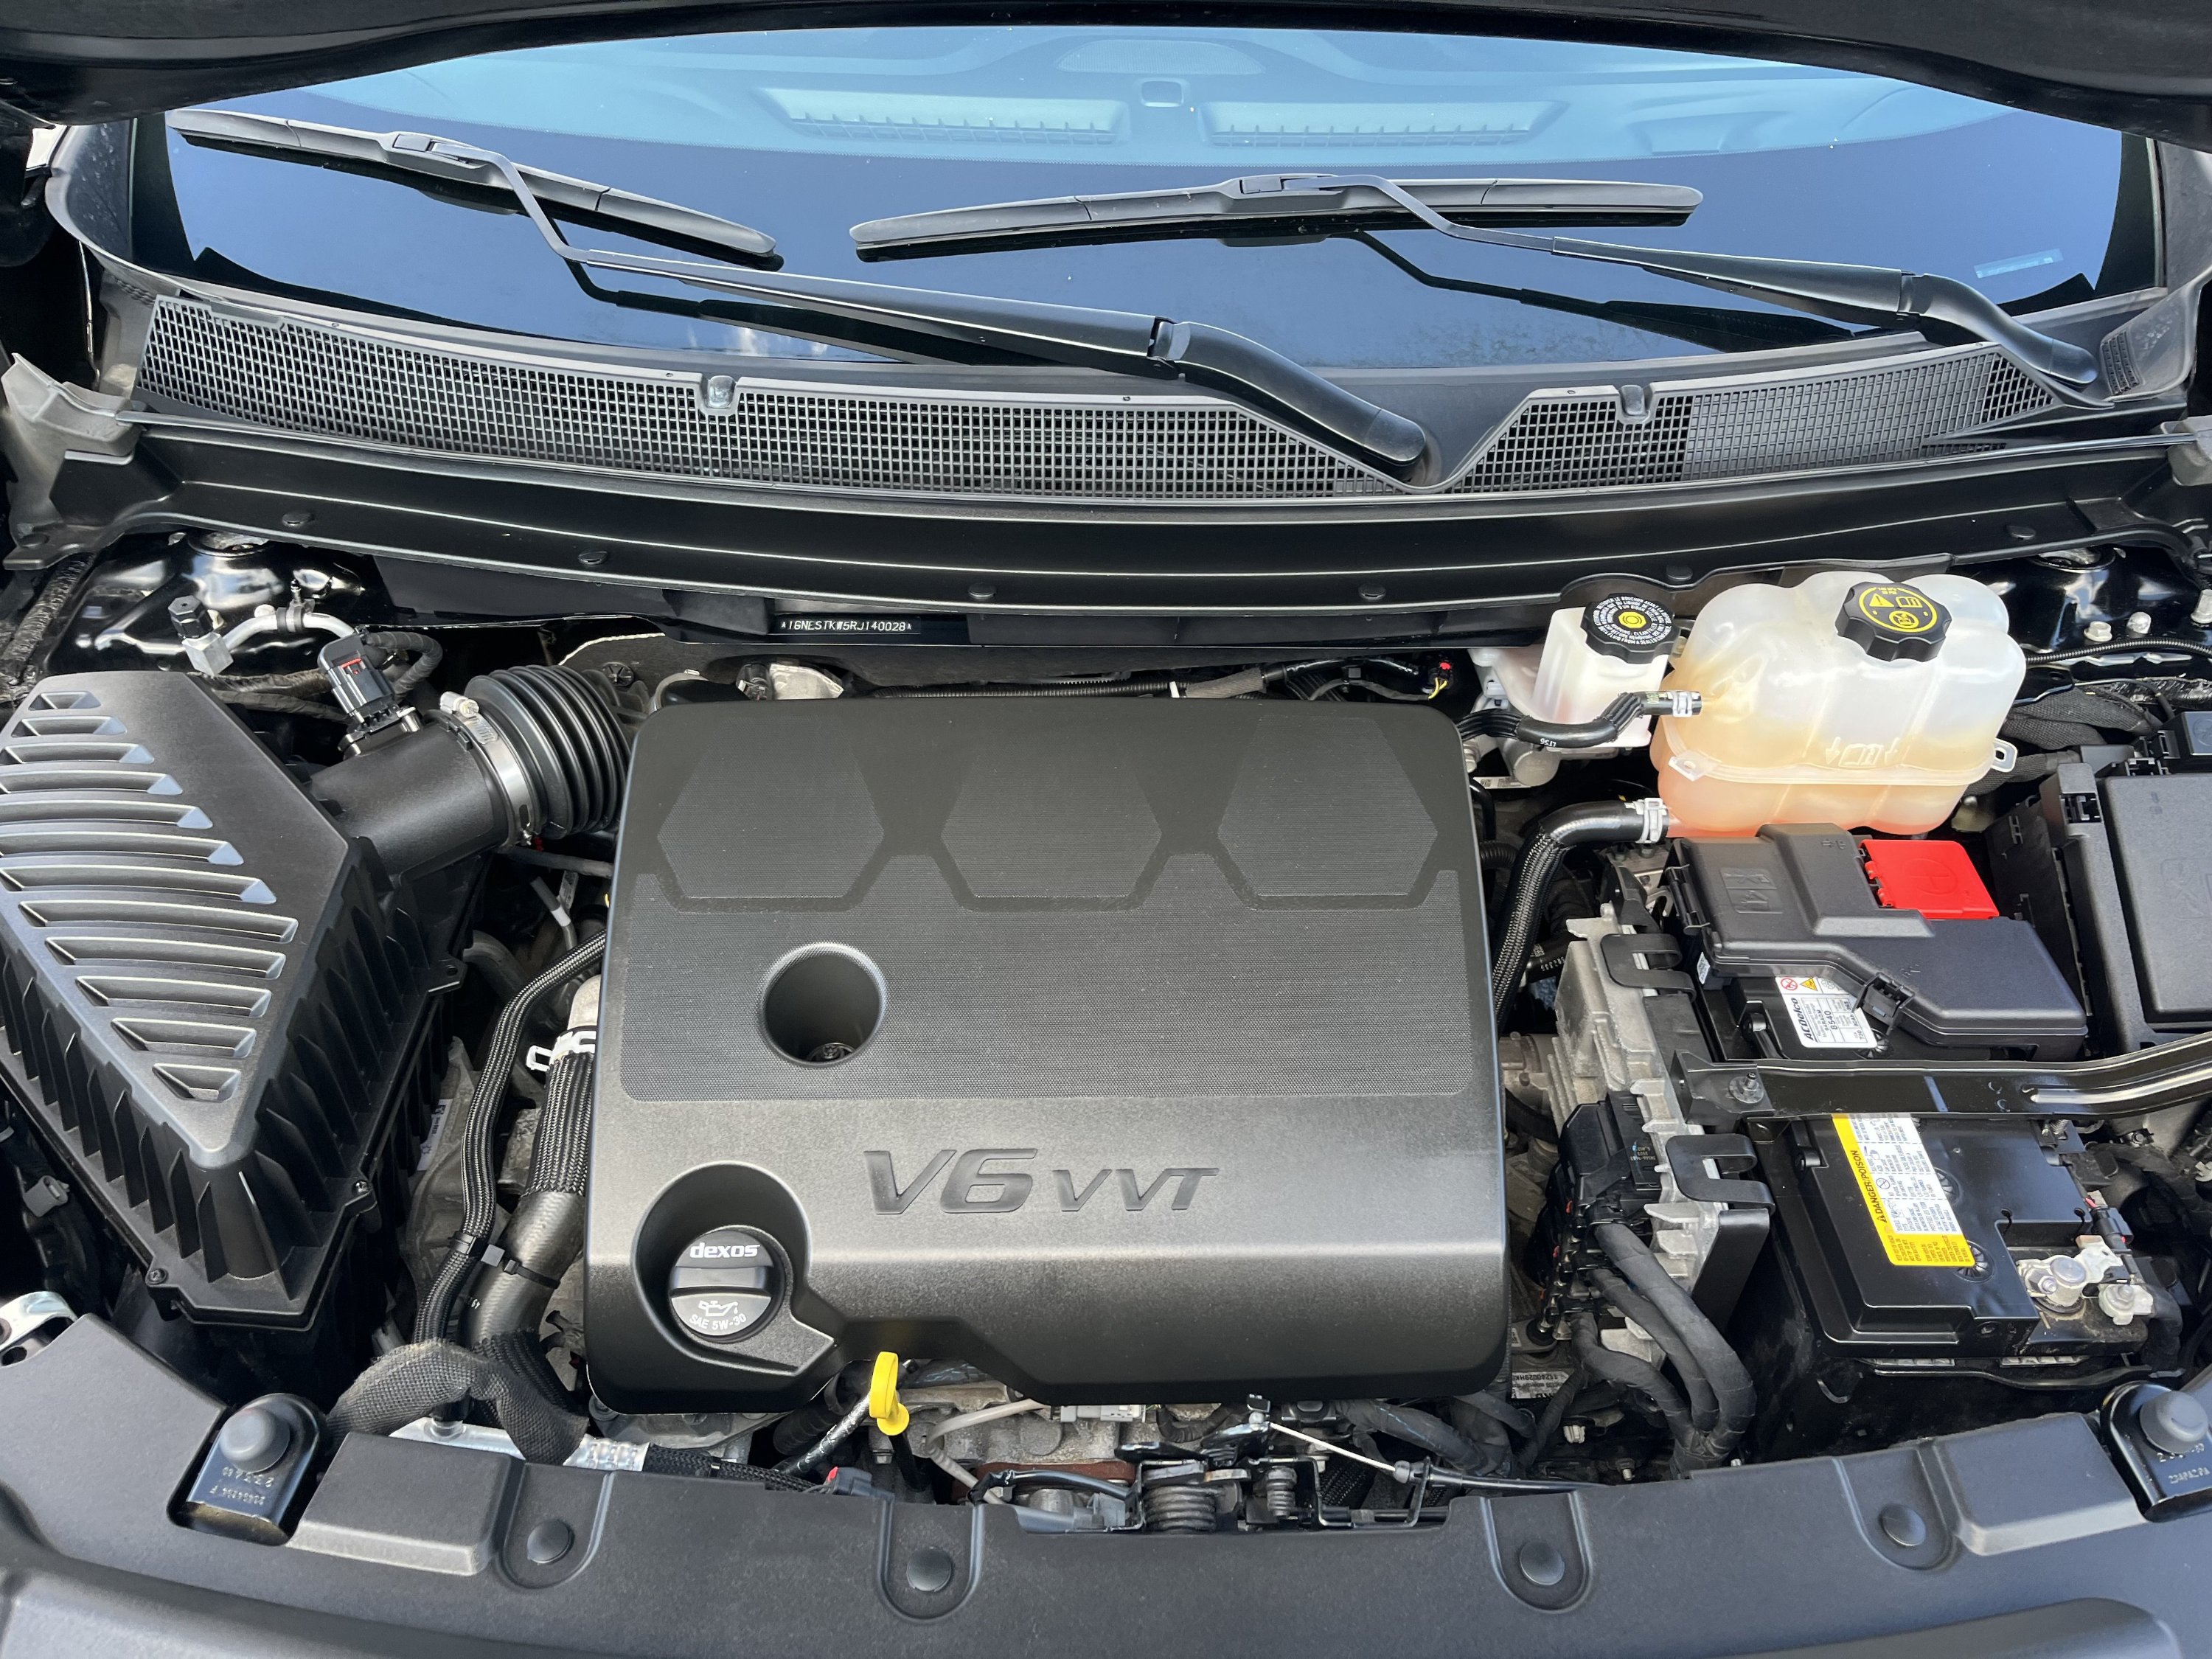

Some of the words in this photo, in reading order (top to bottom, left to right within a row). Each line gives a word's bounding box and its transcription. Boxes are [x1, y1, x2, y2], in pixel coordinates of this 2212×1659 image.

[863, 1148, 1038, 1214] V6
[1052, 1167, 1220, 1211] VVT
[1851, 1150, 1882, 1214] DANGER/POISON
[690, 1242, 760, 1258] dexos
[689, 1314, 709, 1329] SAE
[712, 1313, 747, 1330] 5W-30
